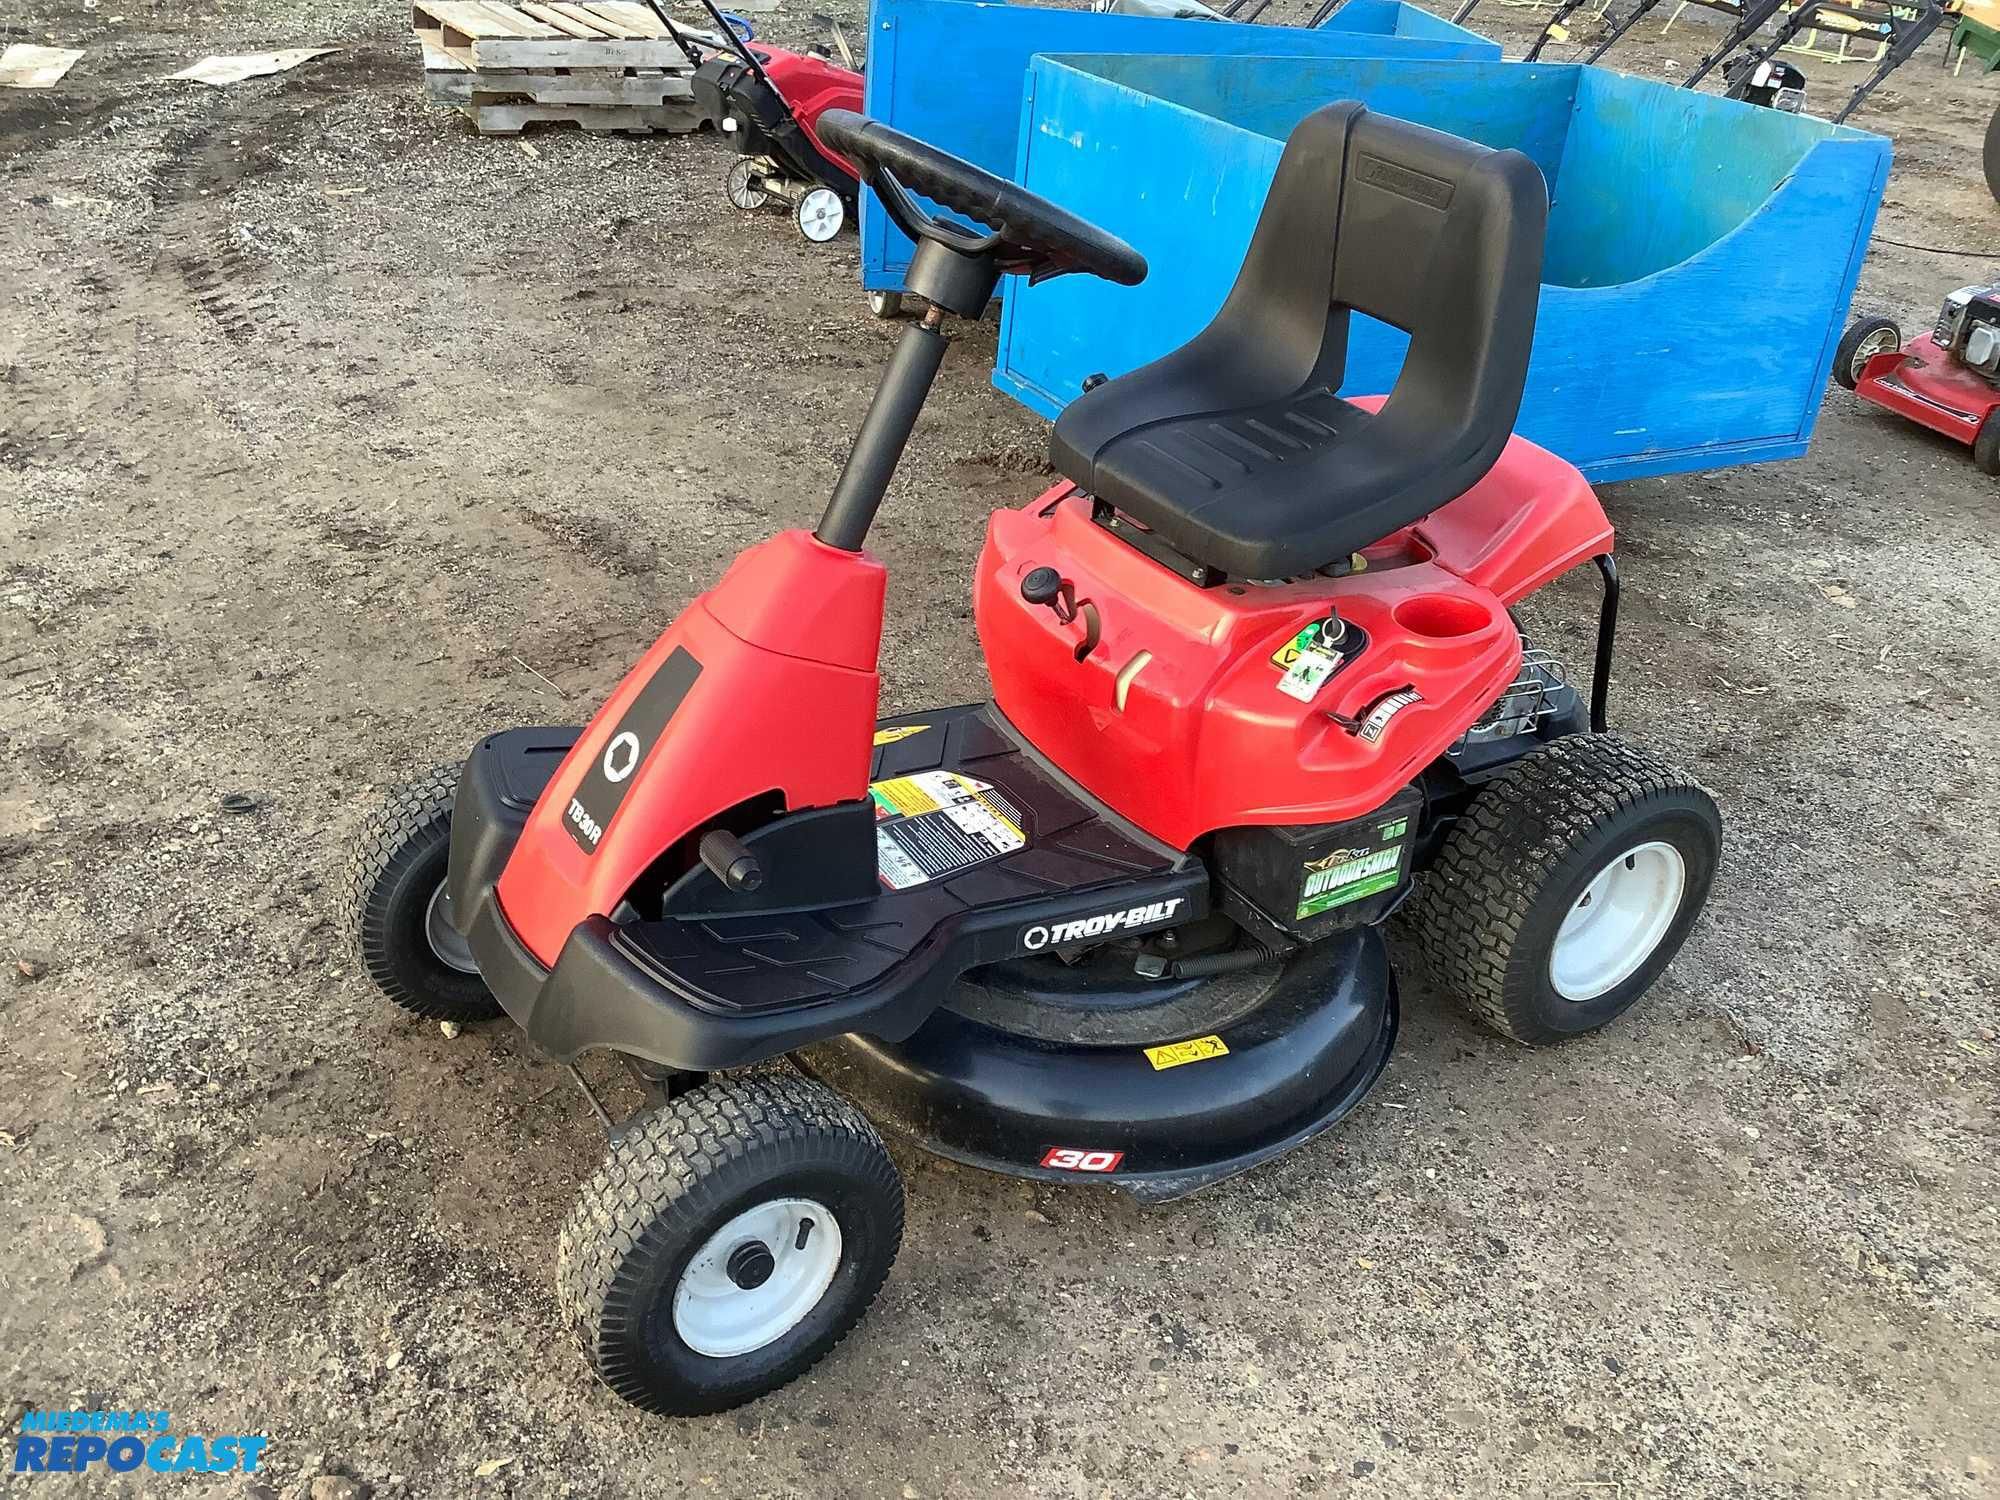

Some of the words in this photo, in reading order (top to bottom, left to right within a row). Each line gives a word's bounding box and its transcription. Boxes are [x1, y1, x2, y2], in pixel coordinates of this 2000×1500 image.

[567, 798, 602, 846] TB30R
[1303, 844, 1402, 898] OUTDOORSMAN
[1051, 898, 1184, 943] TROY-BILT
[1048, 1149, 1115, 1171] 30
